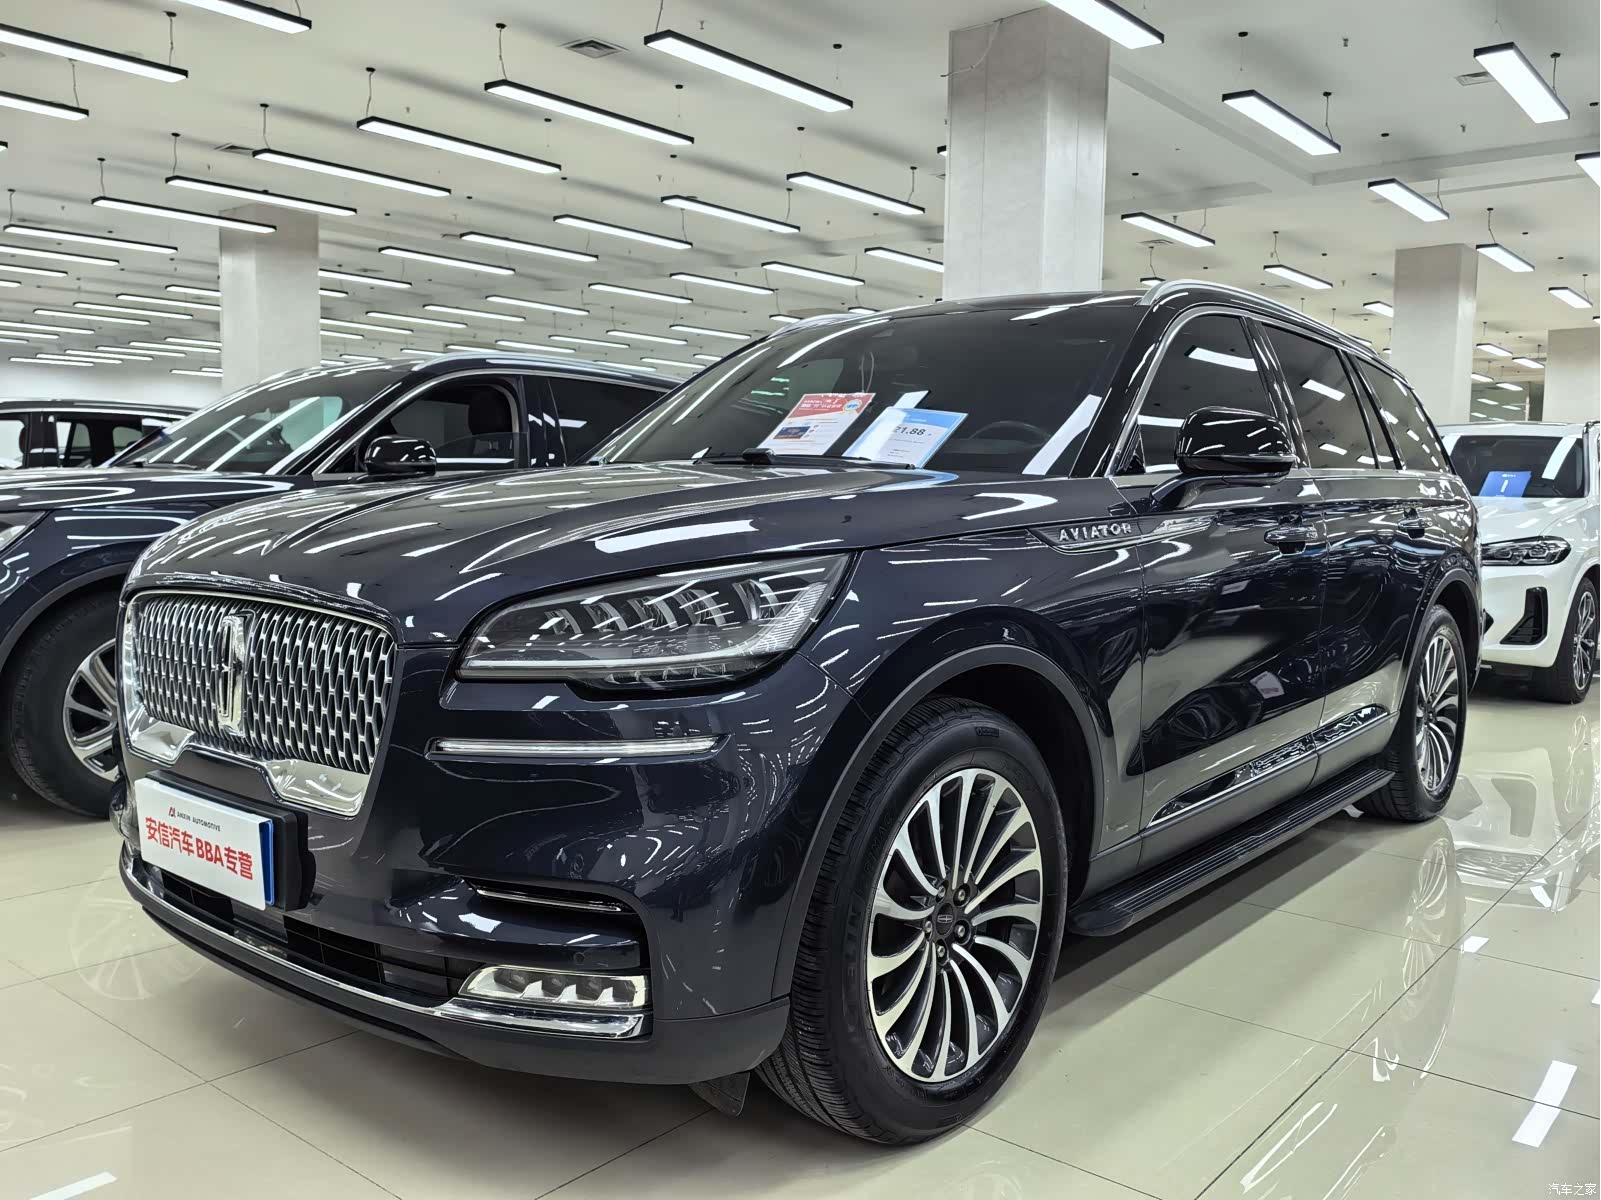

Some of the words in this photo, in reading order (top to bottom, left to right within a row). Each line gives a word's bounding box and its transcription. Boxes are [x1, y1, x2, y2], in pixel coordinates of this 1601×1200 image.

[1059, 522, 1132, 542] AVIATOR
[177, 811, 191, 821] ANXIN
[192, 817, 221, 832] AUTOMOTIVE
